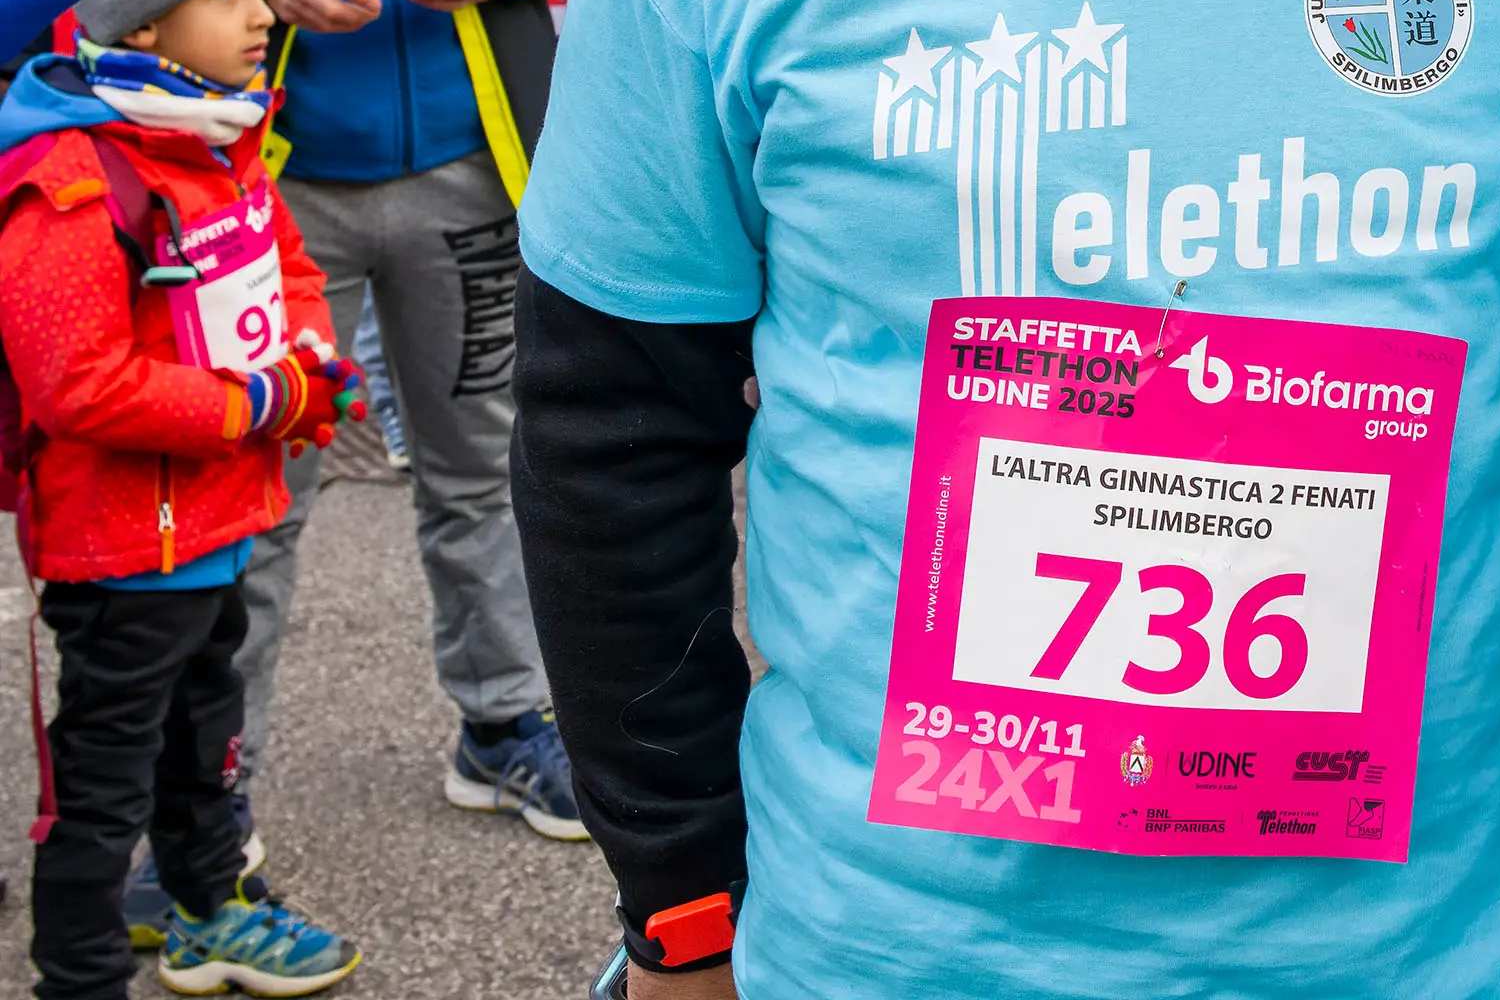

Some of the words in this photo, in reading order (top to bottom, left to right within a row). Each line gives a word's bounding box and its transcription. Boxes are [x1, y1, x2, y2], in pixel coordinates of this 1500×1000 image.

[1332, 47, 1458, 91] SPILIMBERGO
[952, 317, 1143, 357] STAFFETTA
[950, 344, 1139, 387] TELETHON
[947, 374, 1051, 410] UDINE
[1058, 386, 1136, 419] 2025
[1244, 364, 1435, 415] Biofarma
[1365, 418, 1428, 441] group
[1100, 467, 1263, 504] GINNASTICA
[1269, 483, 1284, 505] 2
[1291, 483, 1377, 511] FENATI
[1093, 503, 1273, 540] SPILIMBERGO
[924, 474, 952, 633] www.telethonudine.it
[1029, 551, 1309, 700] 736
[903, 701, 1087, 758] 29-30/11
[895, 740, 1083, 824] 24X1
[1179, 751, 1257, 779] UDINE
[1145, 822, 1171, 833] BNP
[1173, 823, 1226, 834] PARIBAS
[1146, 808, 1172, 819] BNL
[1257, 809, 1317, 835] Telethon
